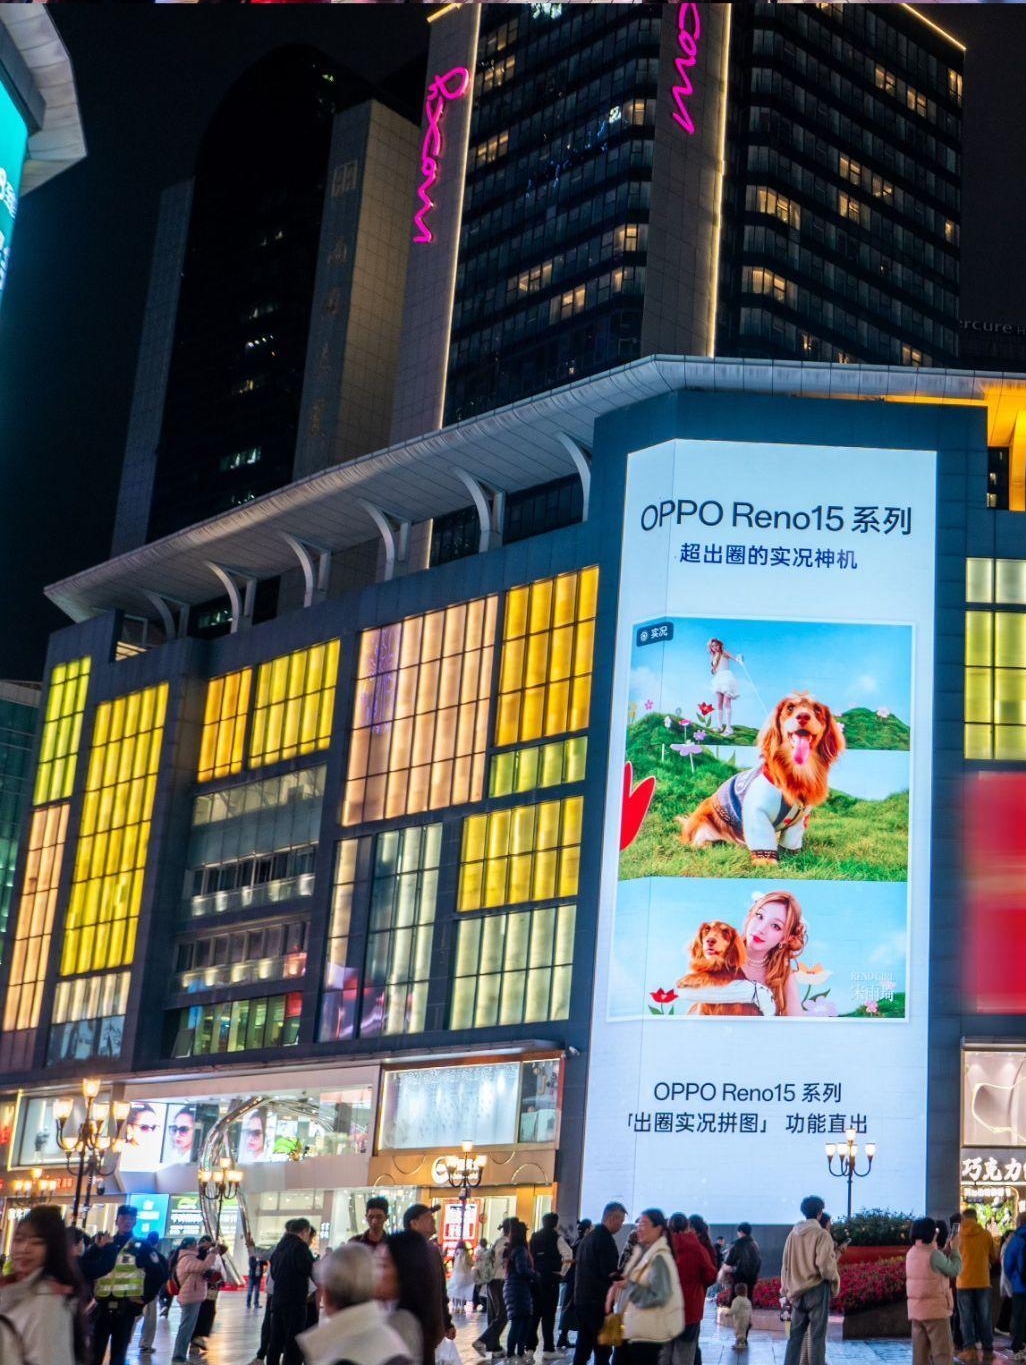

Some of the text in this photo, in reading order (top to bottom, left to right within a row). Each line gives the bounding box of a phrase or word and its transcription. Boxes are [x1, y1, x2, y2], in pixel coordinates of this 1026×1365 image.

[641, 500, 912, 535] OPPO Reno15 系列
[680, 543, 858, 569] 超出圈的实况神机
[653, 1082, 842, 1103] OPPO Reno15 系列
[627, 1112, 868, 1134] 「出圈实况拼图」 功能直出
